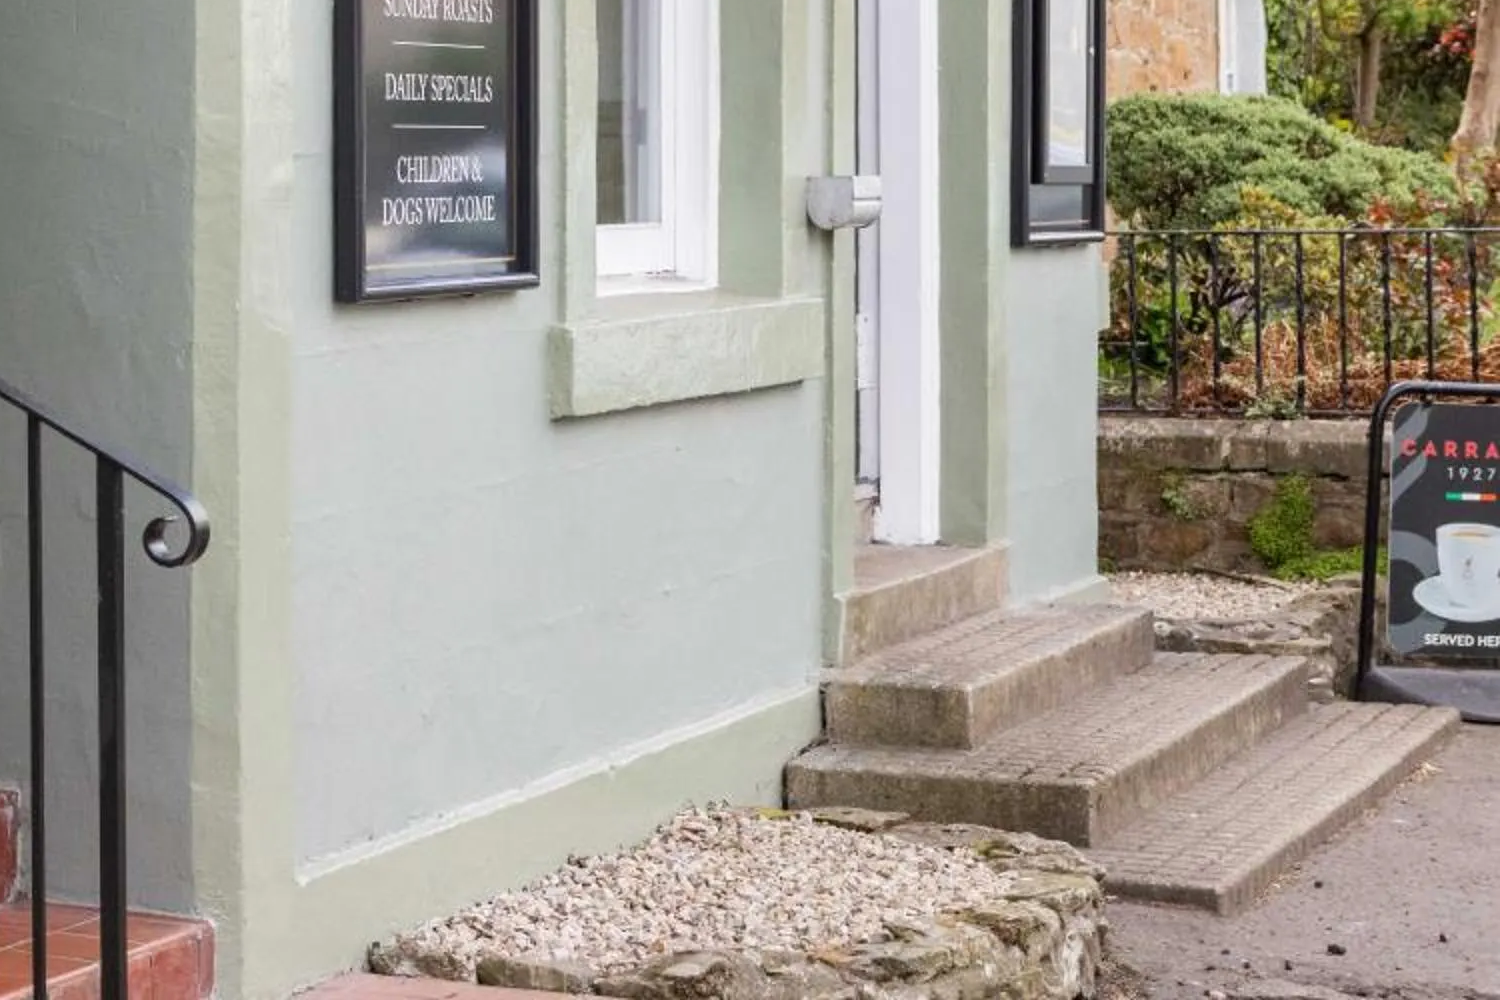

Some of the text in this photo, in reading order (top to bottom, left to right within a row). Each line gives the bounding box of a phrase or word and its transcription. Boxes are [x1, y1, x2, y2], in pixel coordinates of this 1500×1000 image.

[384, 72, 493, 103] DAILY SPECIALS
[396, 155, 484, 184] CHILDREN &
[383, 195, 496, 226] DOGS WELCOME
[1401, 438, 1500, 459] CARRA
[1446, 466, 1497, 482] 1927
[1424, 632, 1475, 648] SERVED
